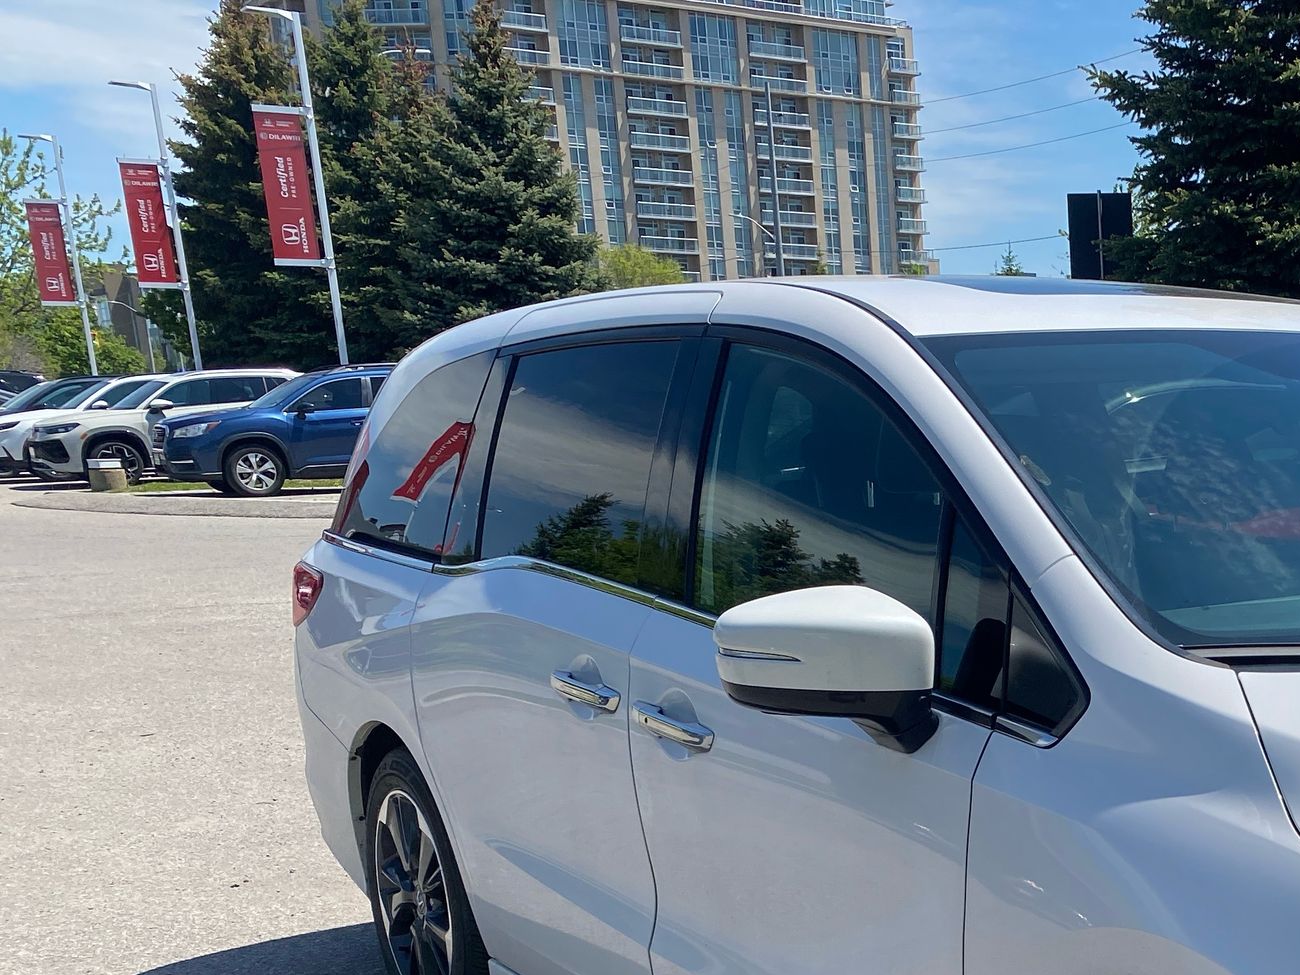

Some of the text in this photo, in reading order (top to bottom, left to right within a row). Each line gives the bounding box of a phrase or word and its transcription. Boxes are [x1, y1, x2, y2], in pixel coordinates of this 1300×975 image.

[274, 156, 289, 198] Certified
[136, 199, 149, 233] Certified
[299, 216, 309, 253] HONDA
[157, 248, 167, 278] HONDA
